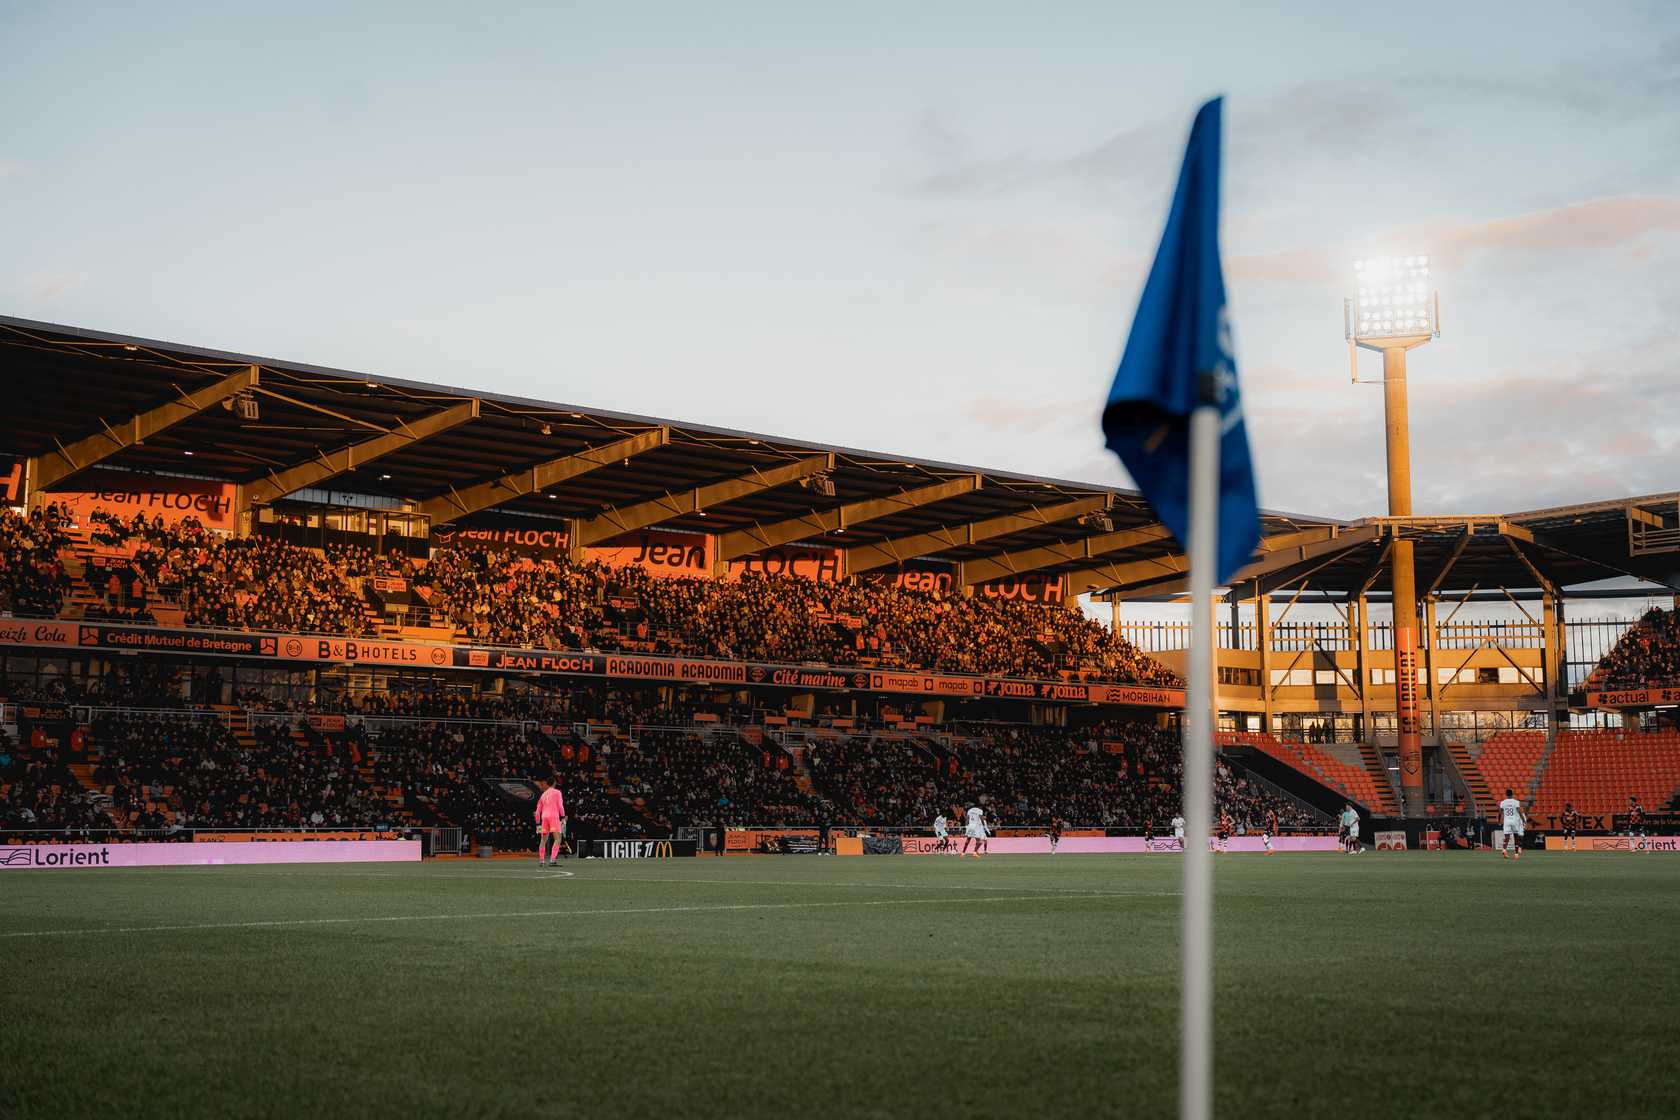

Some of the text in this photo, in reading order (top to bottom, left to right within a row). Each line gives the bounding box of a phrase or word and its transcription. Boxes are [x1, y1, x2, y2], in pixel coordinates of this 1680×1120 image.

[633, 534, 706, 569] Jean
[34, 626, 66, 643] Cola
[106, 631, 252, 652] Crédit Mutuel de Bretagne
[361, 647, 417, 661] HOTELS
[495, 654, 537, 669] JEAN
[609, 660, 675, 676] ACADOMIA
[681, 663, 744, 680] ACADOMIA
[800, 670, 846, 687] marine
[1122, 691, 1170, 703] MORBIHAN
[1609, 691, 1649, 704] actual
[1547, 815, 1605, 830] TEX
[1634, 838, 1677, 850] orient
[35, 847, 109, 866] Lorient
